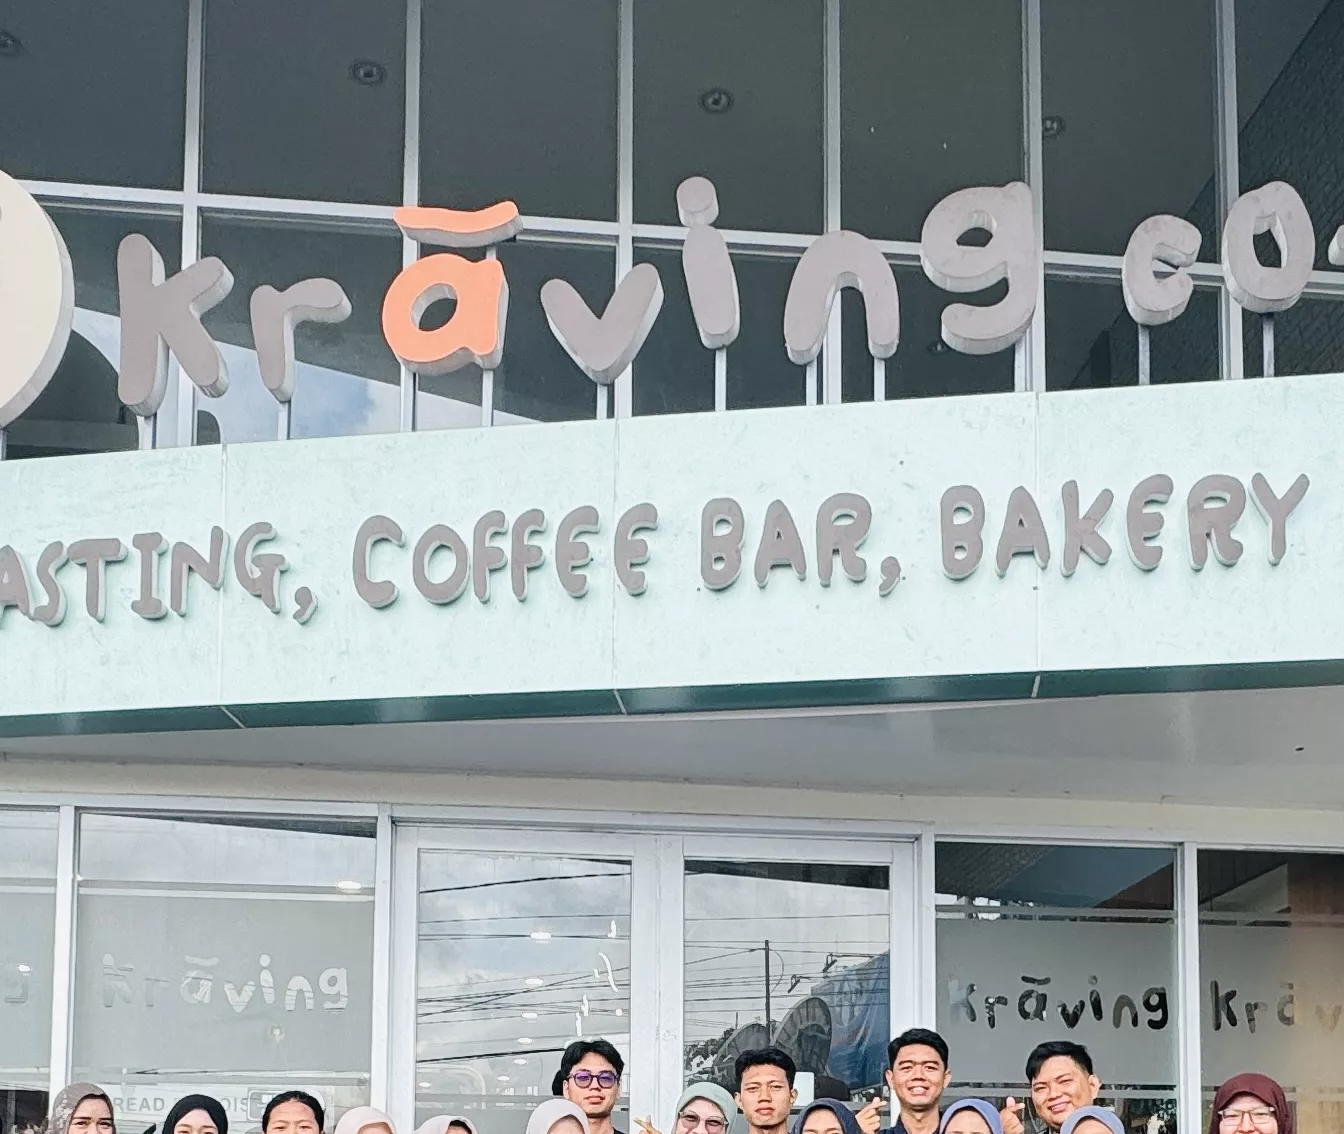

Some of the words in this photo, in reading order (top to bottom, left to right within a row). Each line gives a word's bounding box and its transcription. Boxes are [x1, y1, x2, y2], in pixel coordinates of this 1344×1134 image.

[353, 502, 659, 610] COFFEE
[700, 492, 904, 597] BAR,
[940, 472, 1310, 582] BAKERY
